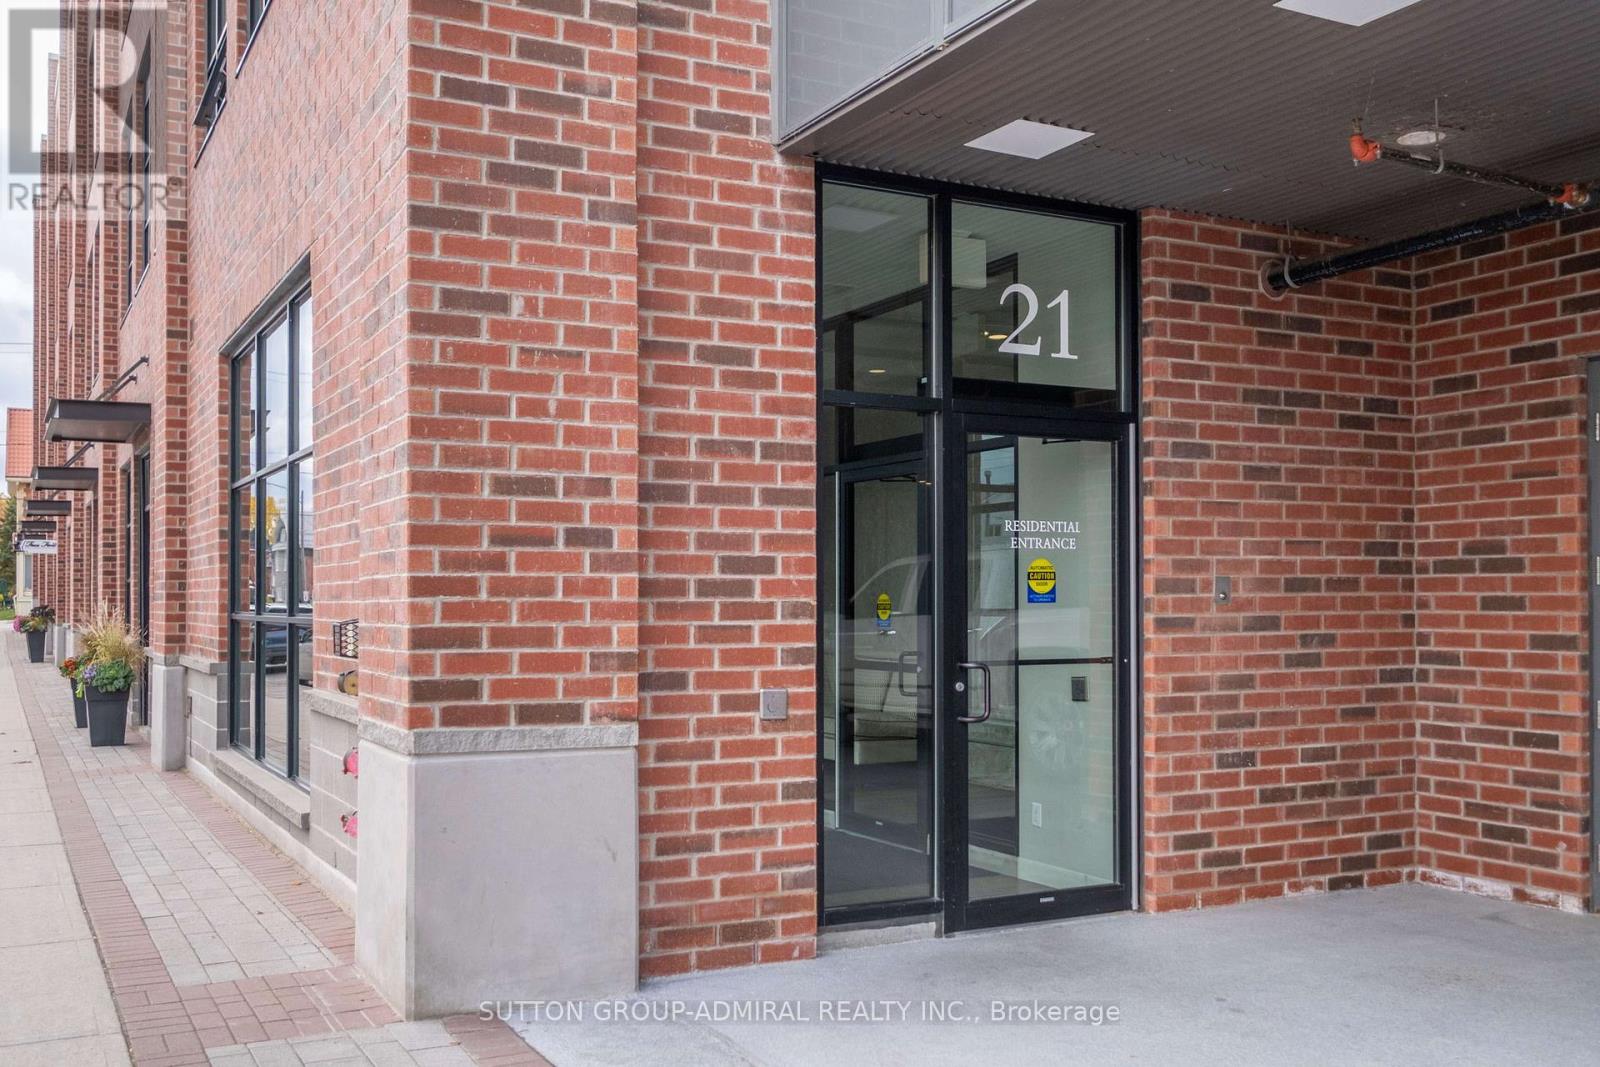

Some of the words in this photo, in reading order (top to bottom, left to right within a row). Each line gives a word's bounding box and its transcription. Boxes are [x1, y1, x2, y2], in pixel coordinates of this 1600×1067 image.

[999, 283, 1078, 359] 21
[1004, 519, 1080, 533] RESIDENTIAL
[1010, 536, 1077, 550] ENTRANCE
[1029, 572, 1055, 580] CAUTION
